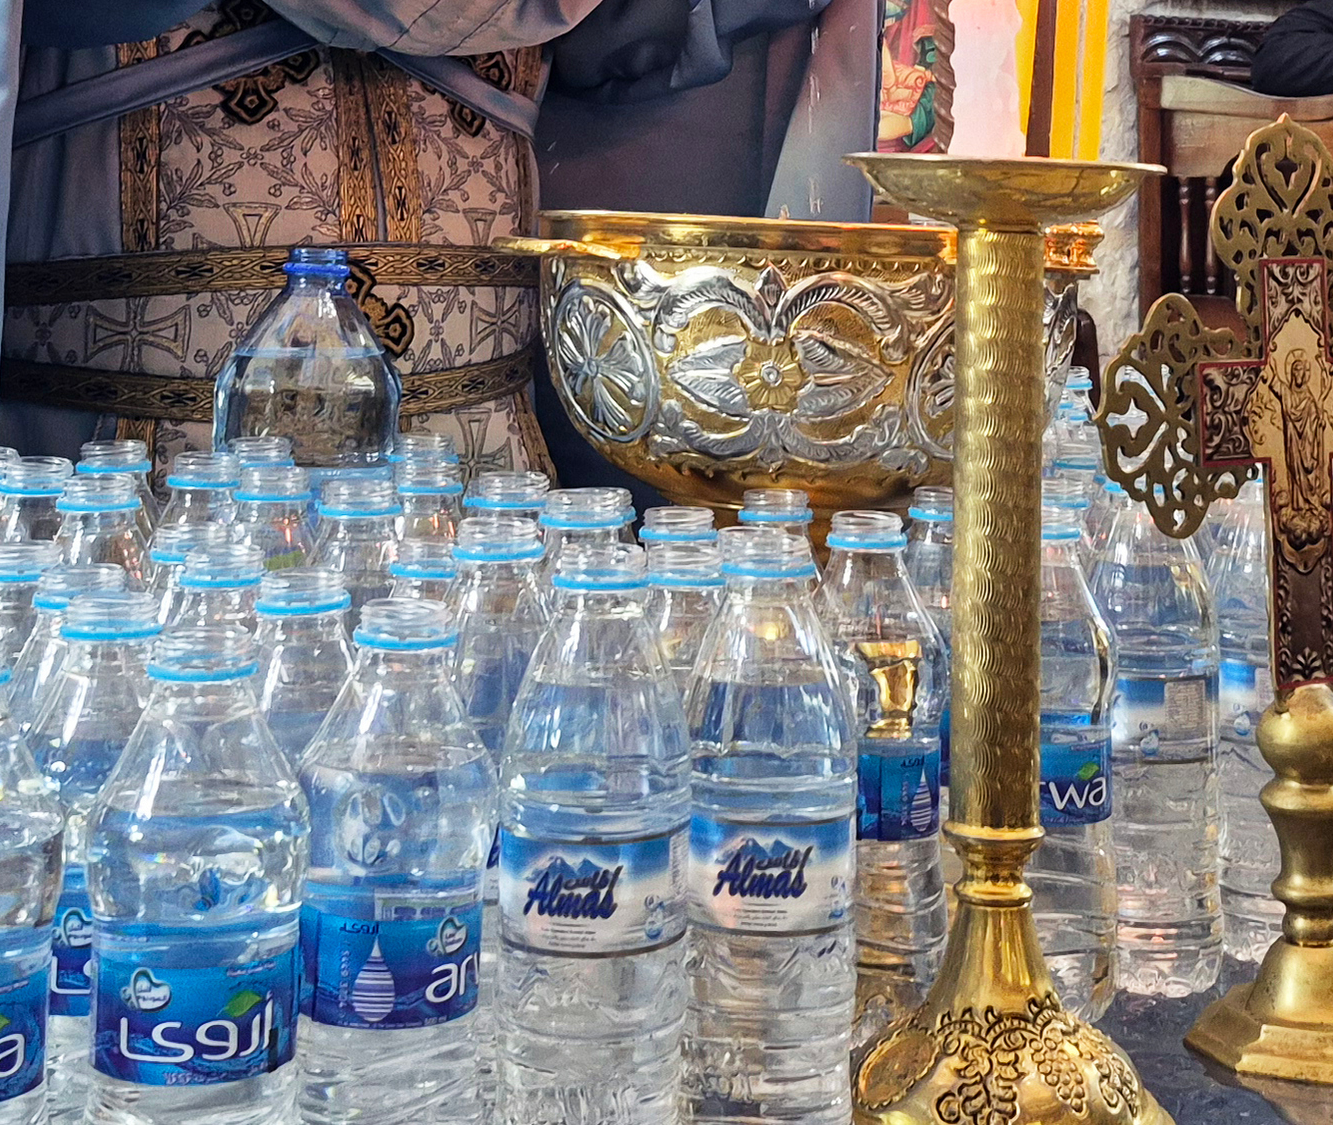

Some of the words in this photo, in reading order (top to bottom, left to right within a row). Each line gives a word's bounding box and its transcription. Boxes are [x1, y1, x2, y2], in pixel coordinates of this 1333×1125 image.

[1040, 776, 1107, 811] wa
[523, 871, 618, 920] Almas
[712, 852, 808, 899] Almas
